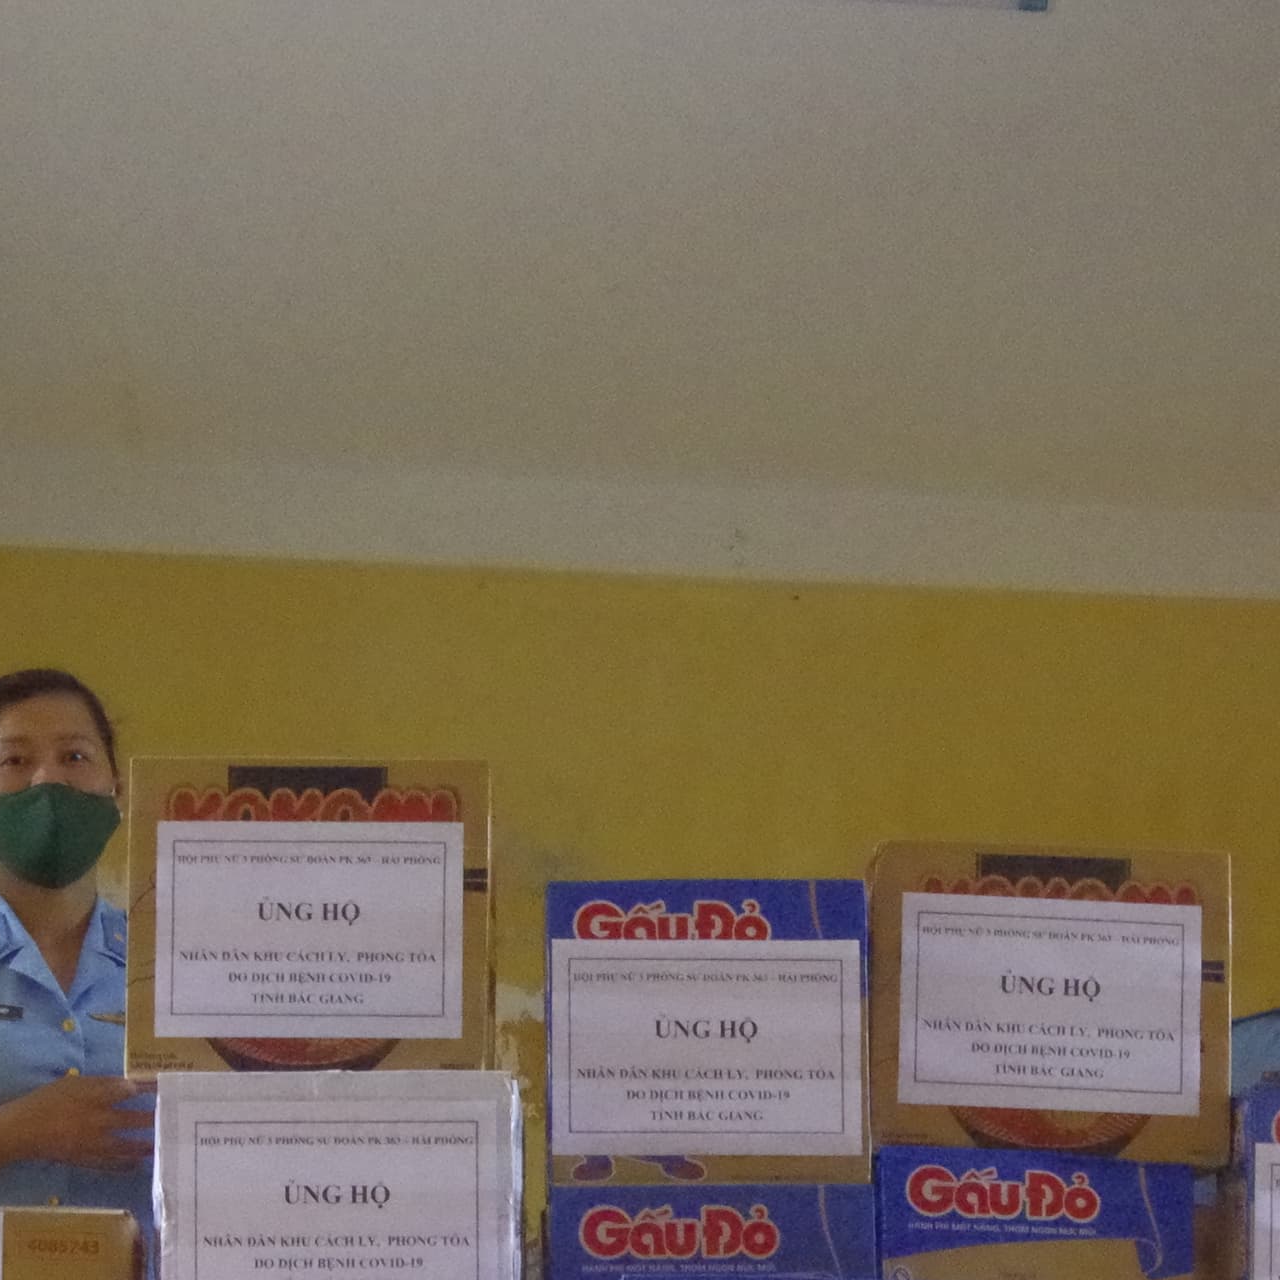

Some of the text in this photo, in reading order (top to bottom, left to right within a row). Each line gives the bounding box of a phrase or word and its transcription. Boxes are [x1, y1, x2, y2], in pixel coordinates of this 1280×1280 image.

[257, 896, 360, 925] ỦNG HỘ
[1000, 969, 1101, 1002] ỦNG HỘ
[654, 1013, 758, 1043] ỦNG HỘ
[283, 1178, 390, 1209] ỦNG HỘ
